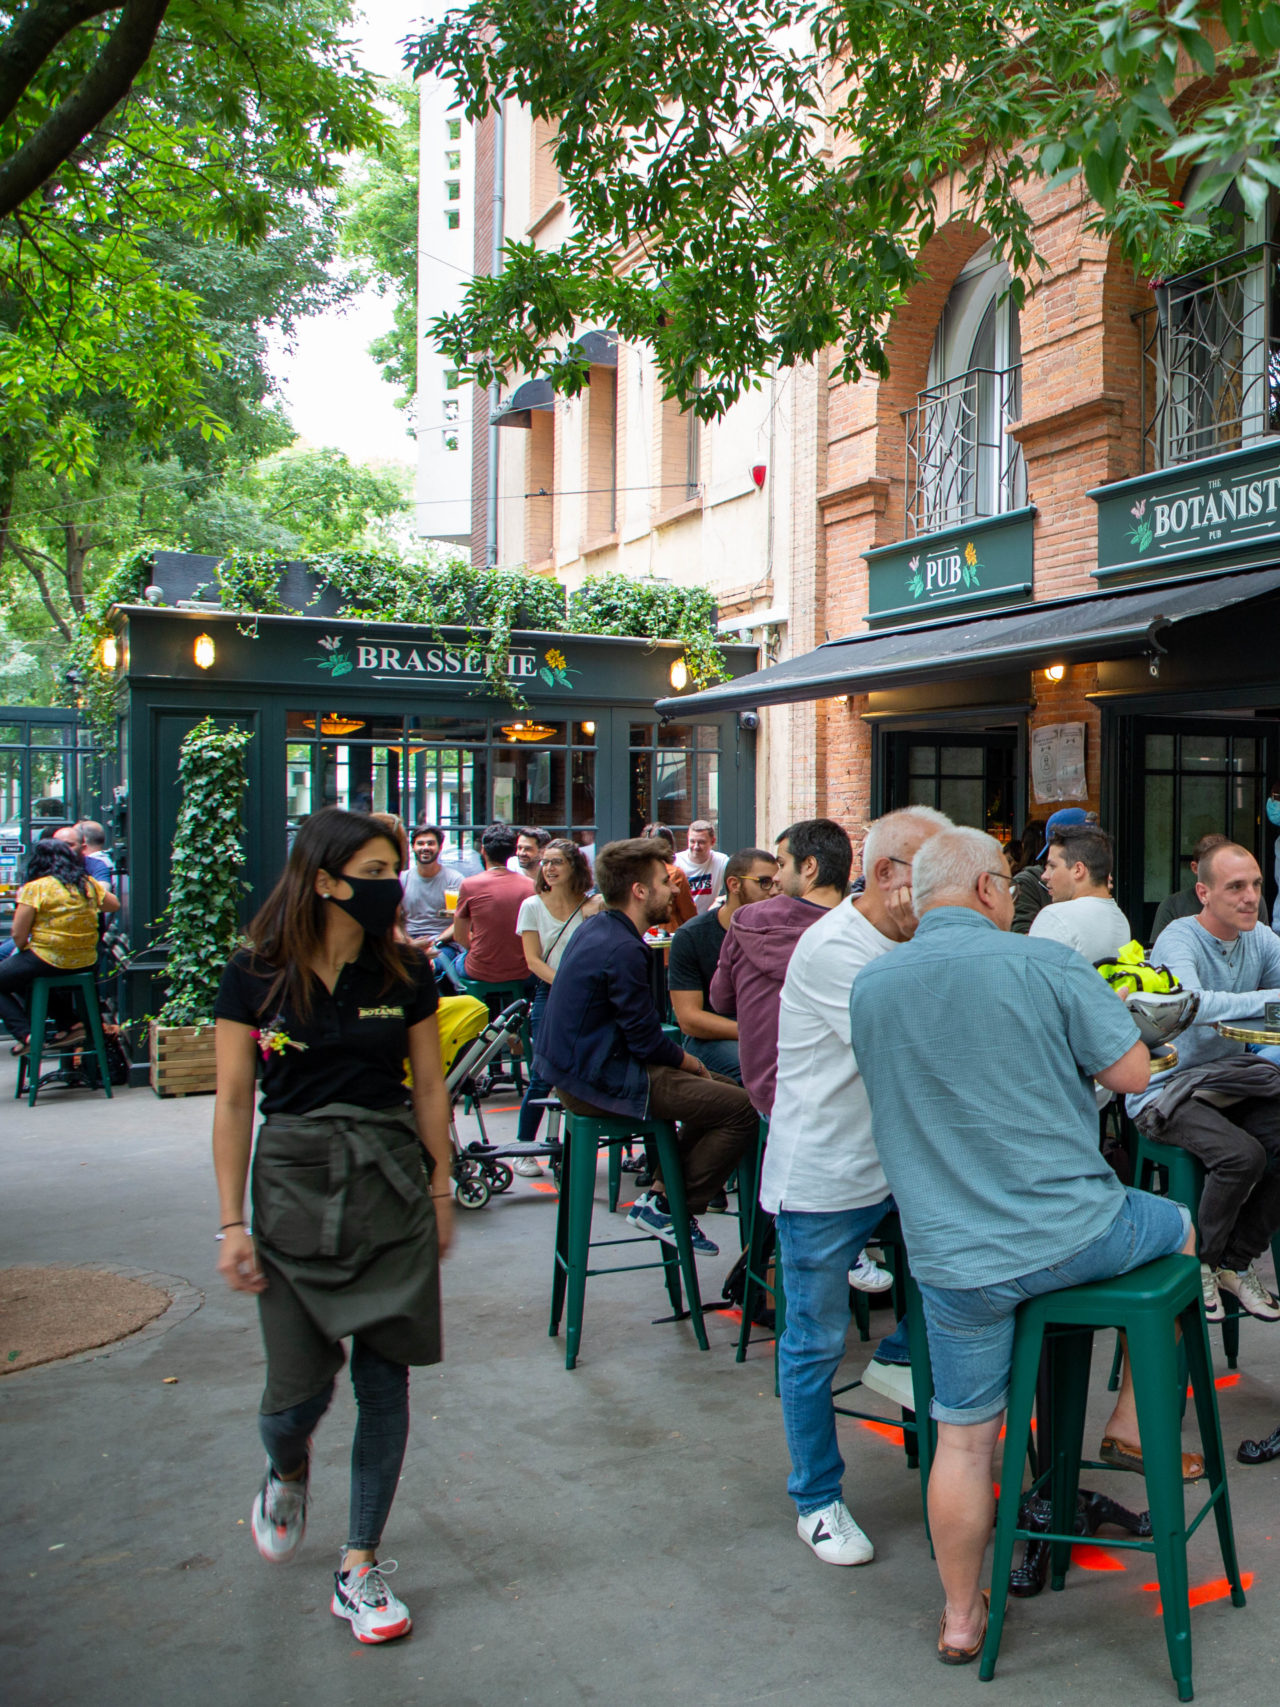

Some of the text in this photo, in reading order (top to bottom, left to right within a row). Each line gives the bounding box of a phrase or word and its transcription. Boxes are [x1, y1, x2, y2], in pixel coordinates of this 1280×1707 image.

[1208, 478, 1222, 490] THE
[1208, 529, 1222, 541] PUB
[925, 555, 962, 591] PUB
